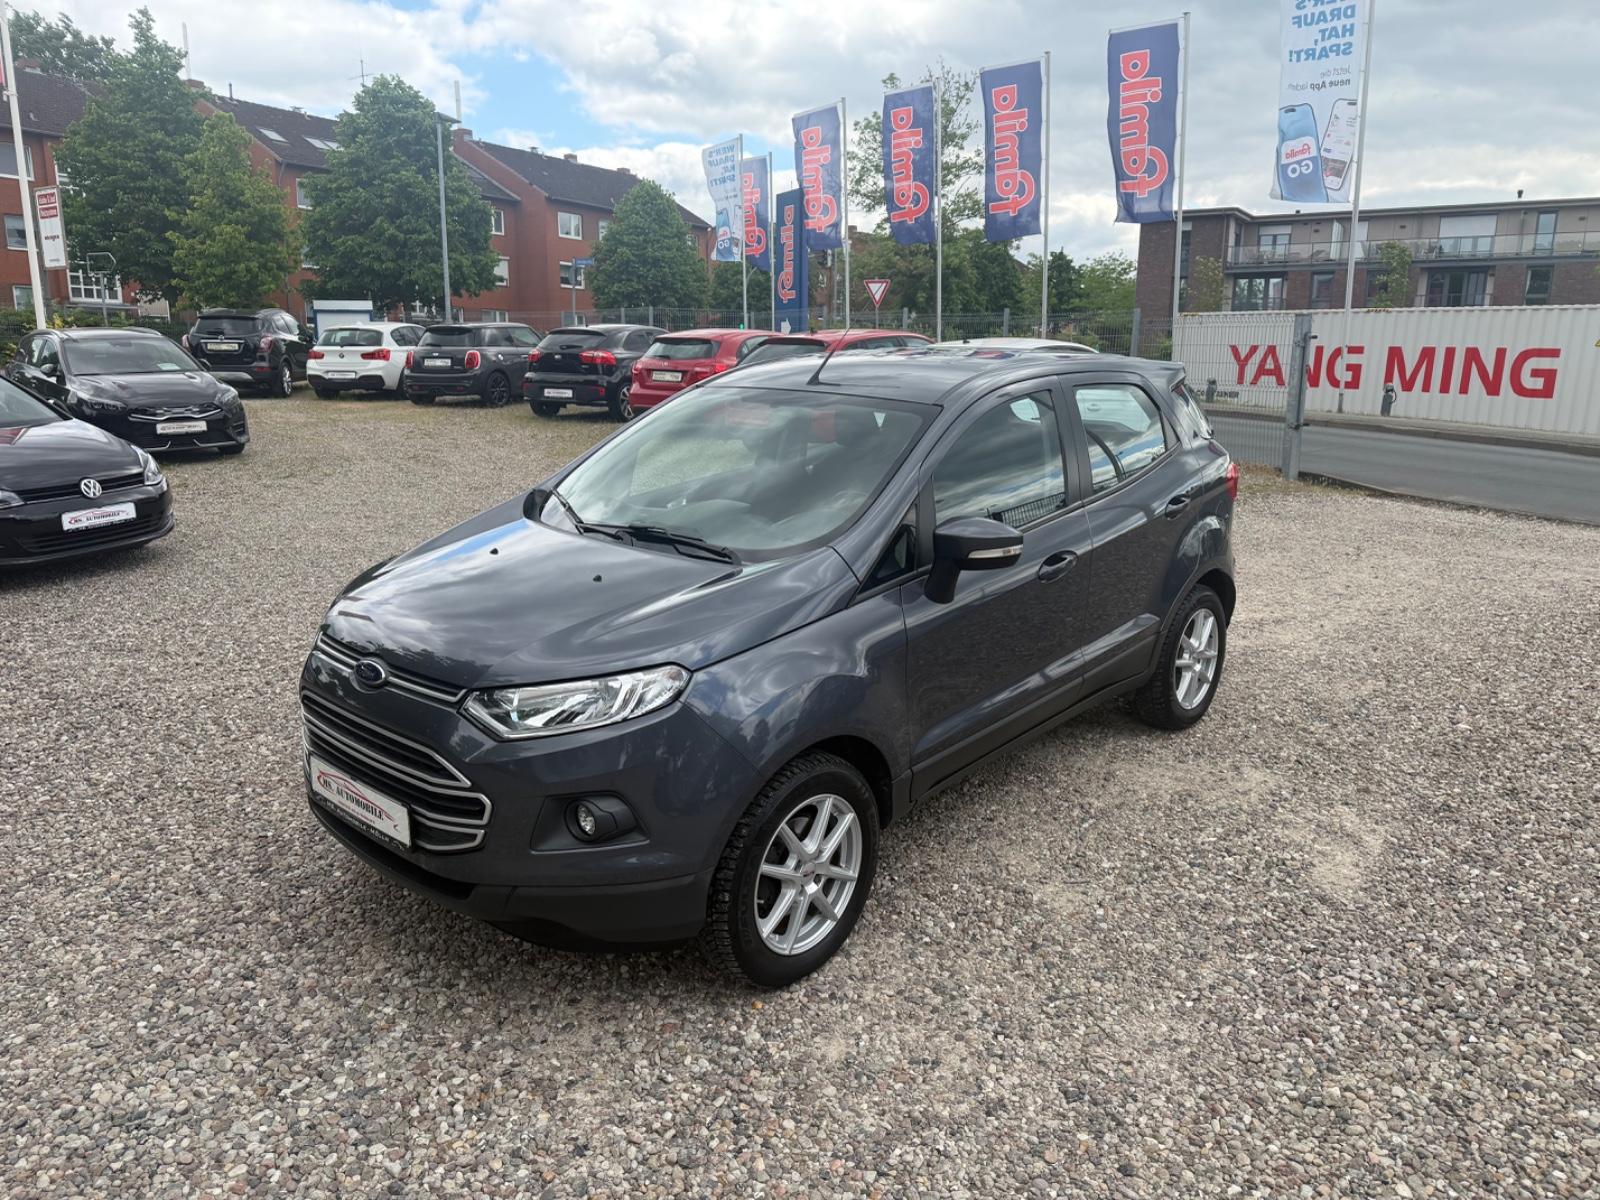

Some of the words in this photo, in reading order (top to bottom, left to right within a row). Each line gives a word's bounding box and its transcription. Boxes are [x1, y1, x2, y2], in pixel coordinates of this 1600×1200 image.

[777, 204, 797, 304] famila
[1229, 344, 1365, 390] YANG
[1382, 345, 1562, 399] MING
